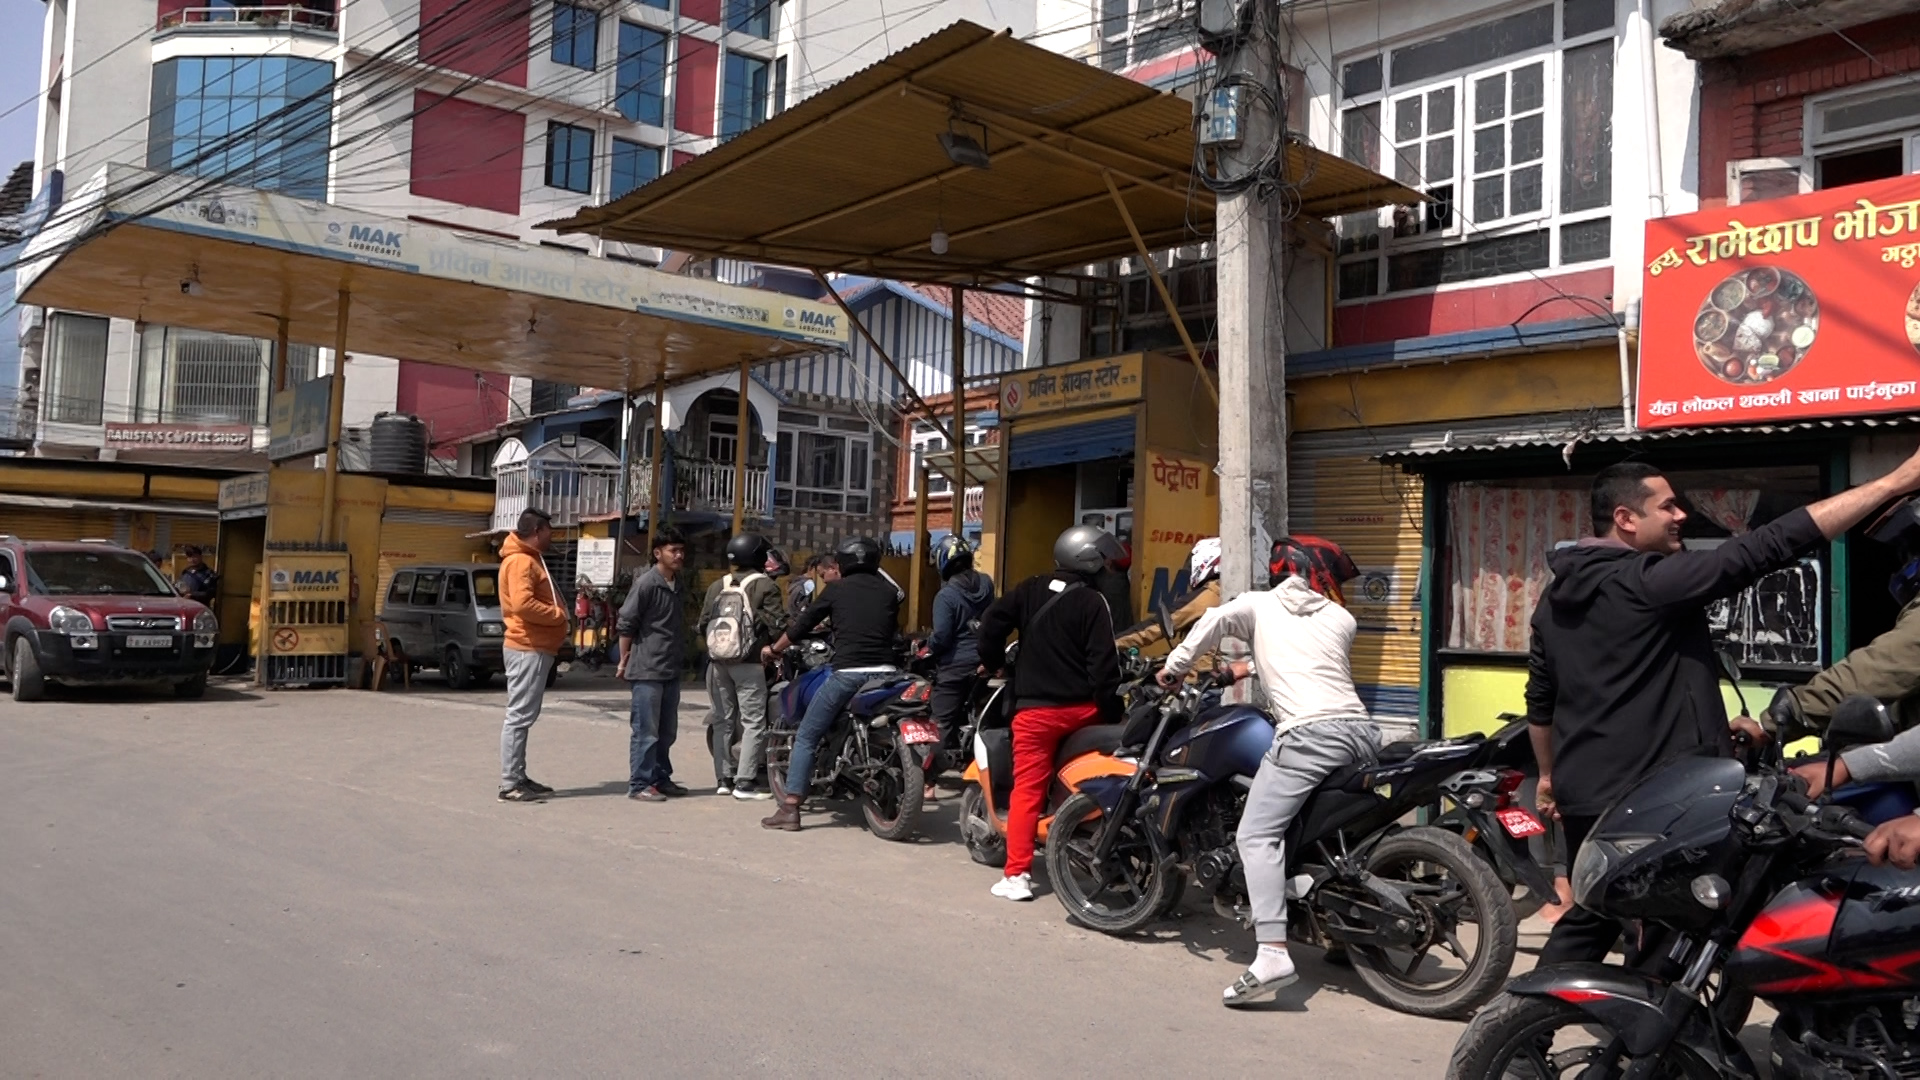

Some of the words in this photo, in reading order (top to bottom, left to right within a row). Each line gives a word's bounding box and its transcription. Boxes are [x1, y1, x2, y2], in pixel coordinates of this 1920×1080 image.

[349, 224, 402, 248] MAK
[1686, 216, 1823, 266] रामेछाप
[800, 309, 836, 328] MAK
[1682, 396, 1734, 414] लोकल
[1797, 387, 1841, 404] खाना
[212, 432, 247, 446] SHOP
[1152, 457, 1200, 492] पेट्रोल
[1150, 529, 1219, 545] SIPRA
[293, 570, 340, 584] MAK
